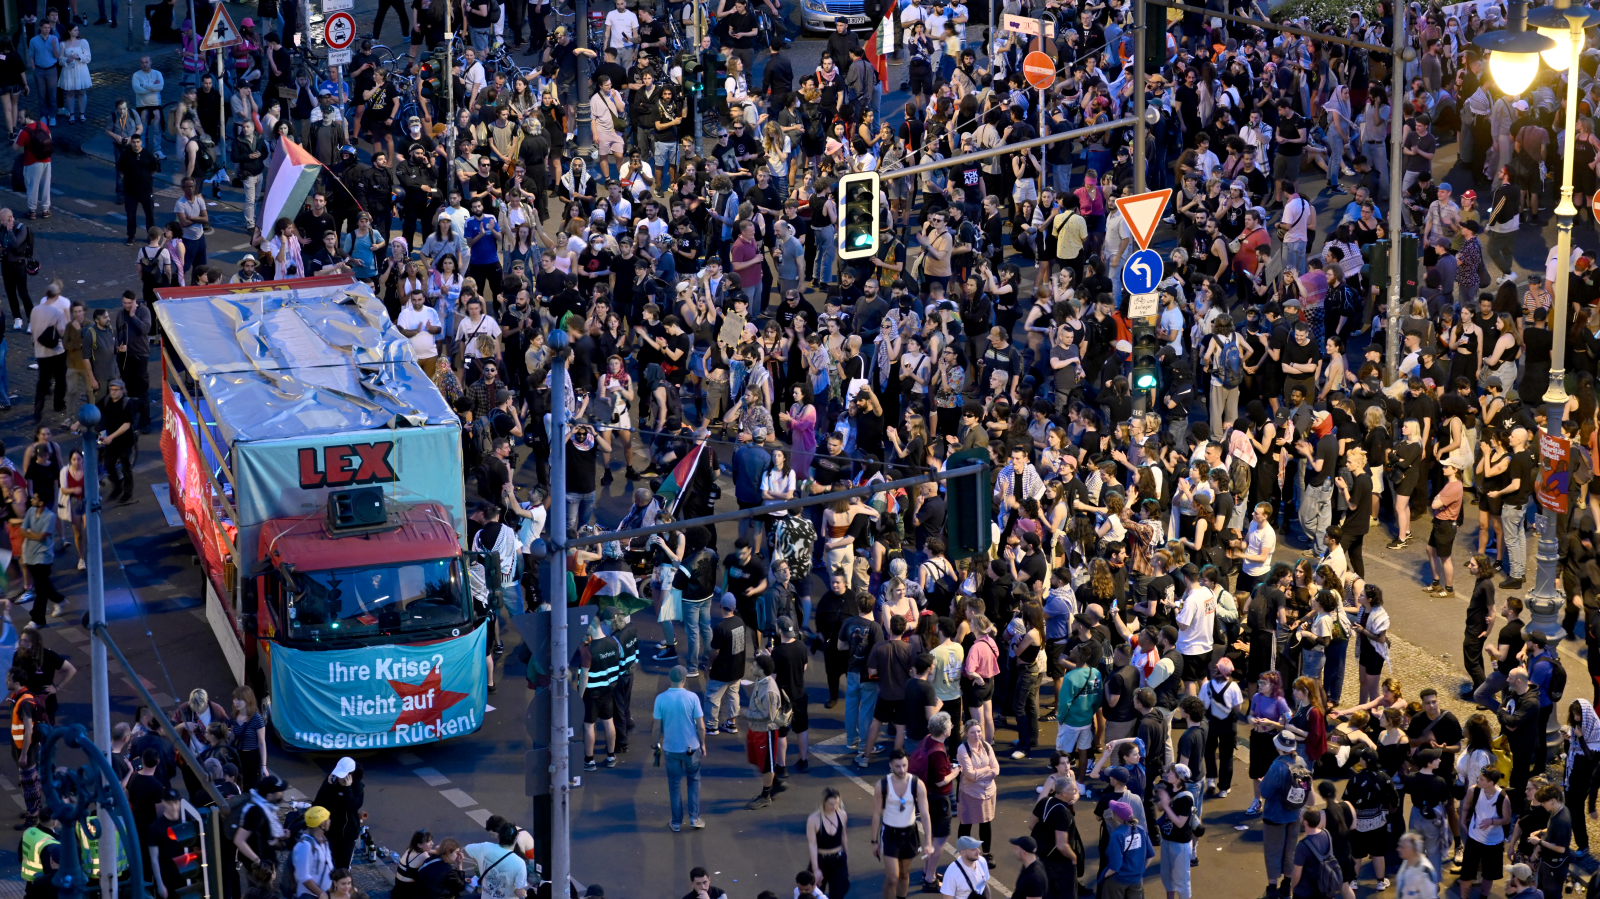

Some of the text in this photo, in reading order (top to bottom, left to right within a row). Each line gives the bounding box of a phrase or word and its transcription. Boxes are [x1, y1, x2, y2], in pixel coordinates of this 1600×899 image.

[964, 170, 978, 178] FCK
[964, 177, 978, 185] AFD
[298, 440, 400, 489] LEX
[329, 653, 444, 683] Ihre Krise?
[340, 688, 435, 717] Nicht auf
[396, 708, 477, 744] Rücken!
